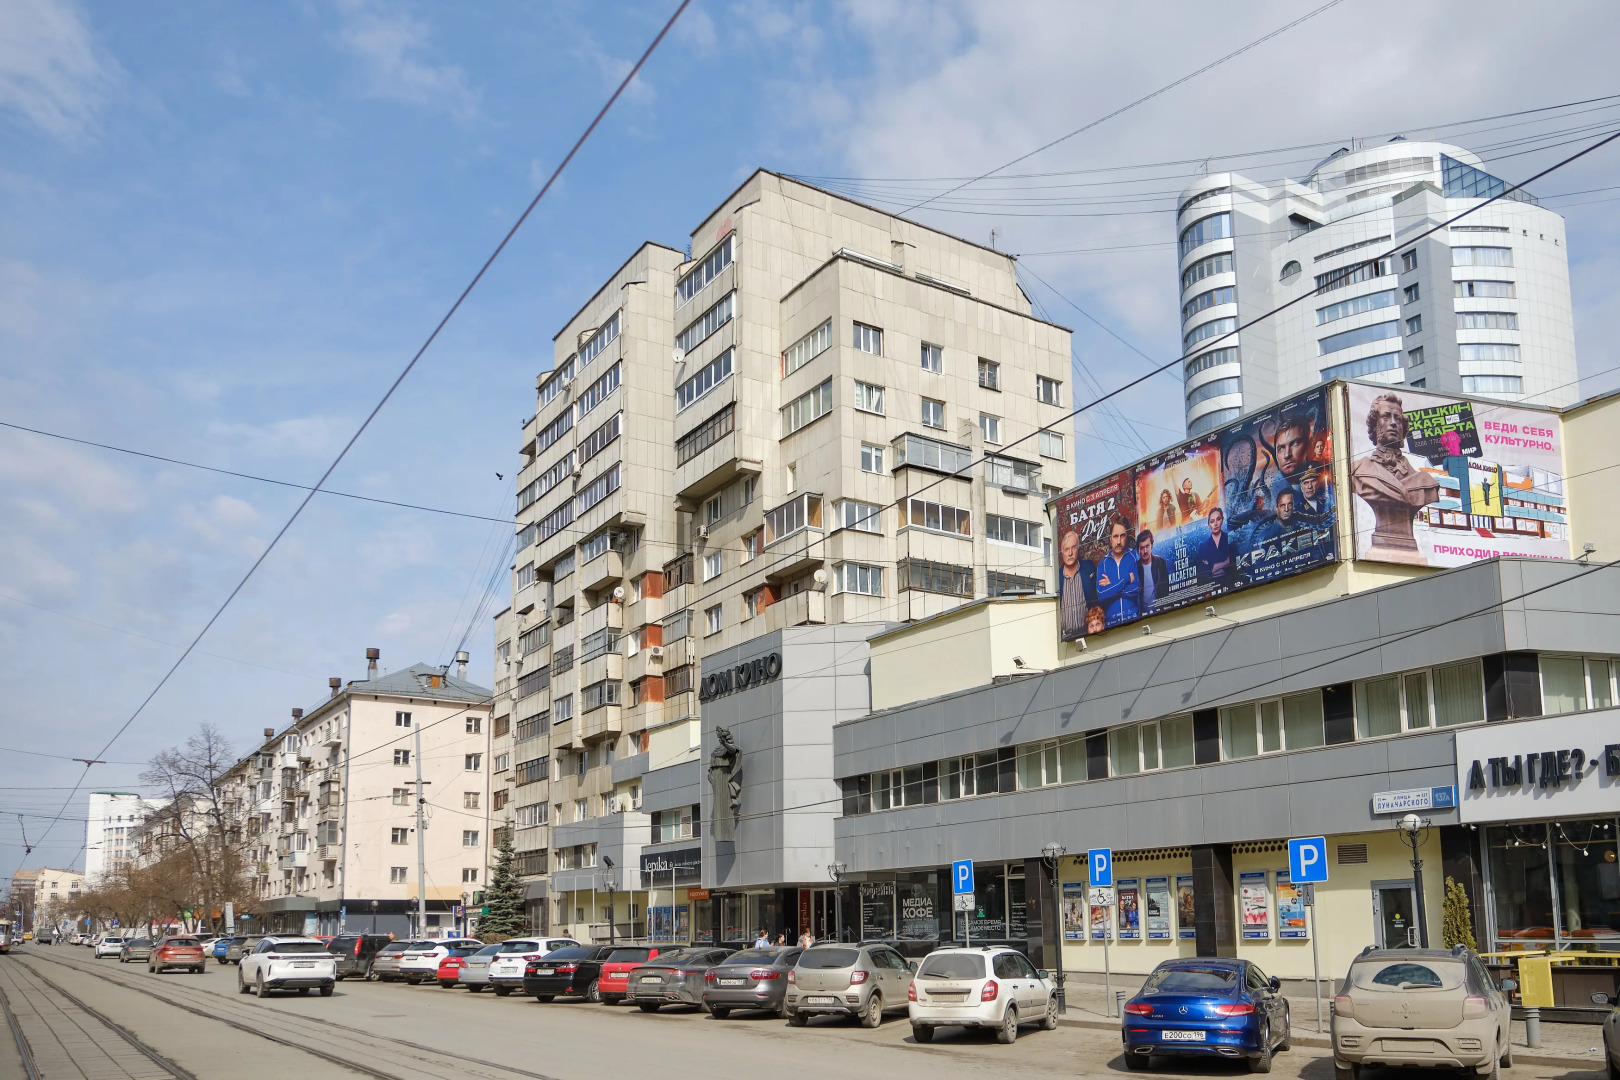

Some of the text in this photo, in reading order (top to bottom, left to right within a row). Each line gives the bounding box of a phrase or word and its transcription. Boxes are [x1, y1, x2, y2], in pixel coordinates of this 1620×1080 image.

[1402, 402, 1471, 421] ПУШКИН
[1423, 421, 1475, 438] КАРТА
[1484, 421, 1554, 438] ВЕДИ СЕБЯ
[1484, 434, 1555, 452] КУЛЬТУРНО,
[1070, 498, 1086, 509] КИНО
[1095, 483, 1118, 498] АПРЕЛЯ
[1069, 497, 1116, 526] БАТЯ 2
[1175, 547, 1187, 560] ЧТО
[1235, 527, 1331, 571] КРАКЕН
[1433, 544, 1491, 559] ПРИХОДИ
[1174, 557, 1189, 572] ТЕБЯ
[1259, 564, 1275, 573] КИНО
[1288, 552, 1311, 564] АПРЕЛЯ
[1168, 565, 1197, 584] КАСАЕТСЯ
[698, 652, 782, 701] ДОМ КИНО
[1469, 743, 1620, 790] А ТЫ ГДЕ? Б
[1377, 797, 1429, 810] ЛУНАЧАРСКОГО
[902, 897, 933, 907] МЕДИА
[902, 906, 934, 919] КОФЕ
